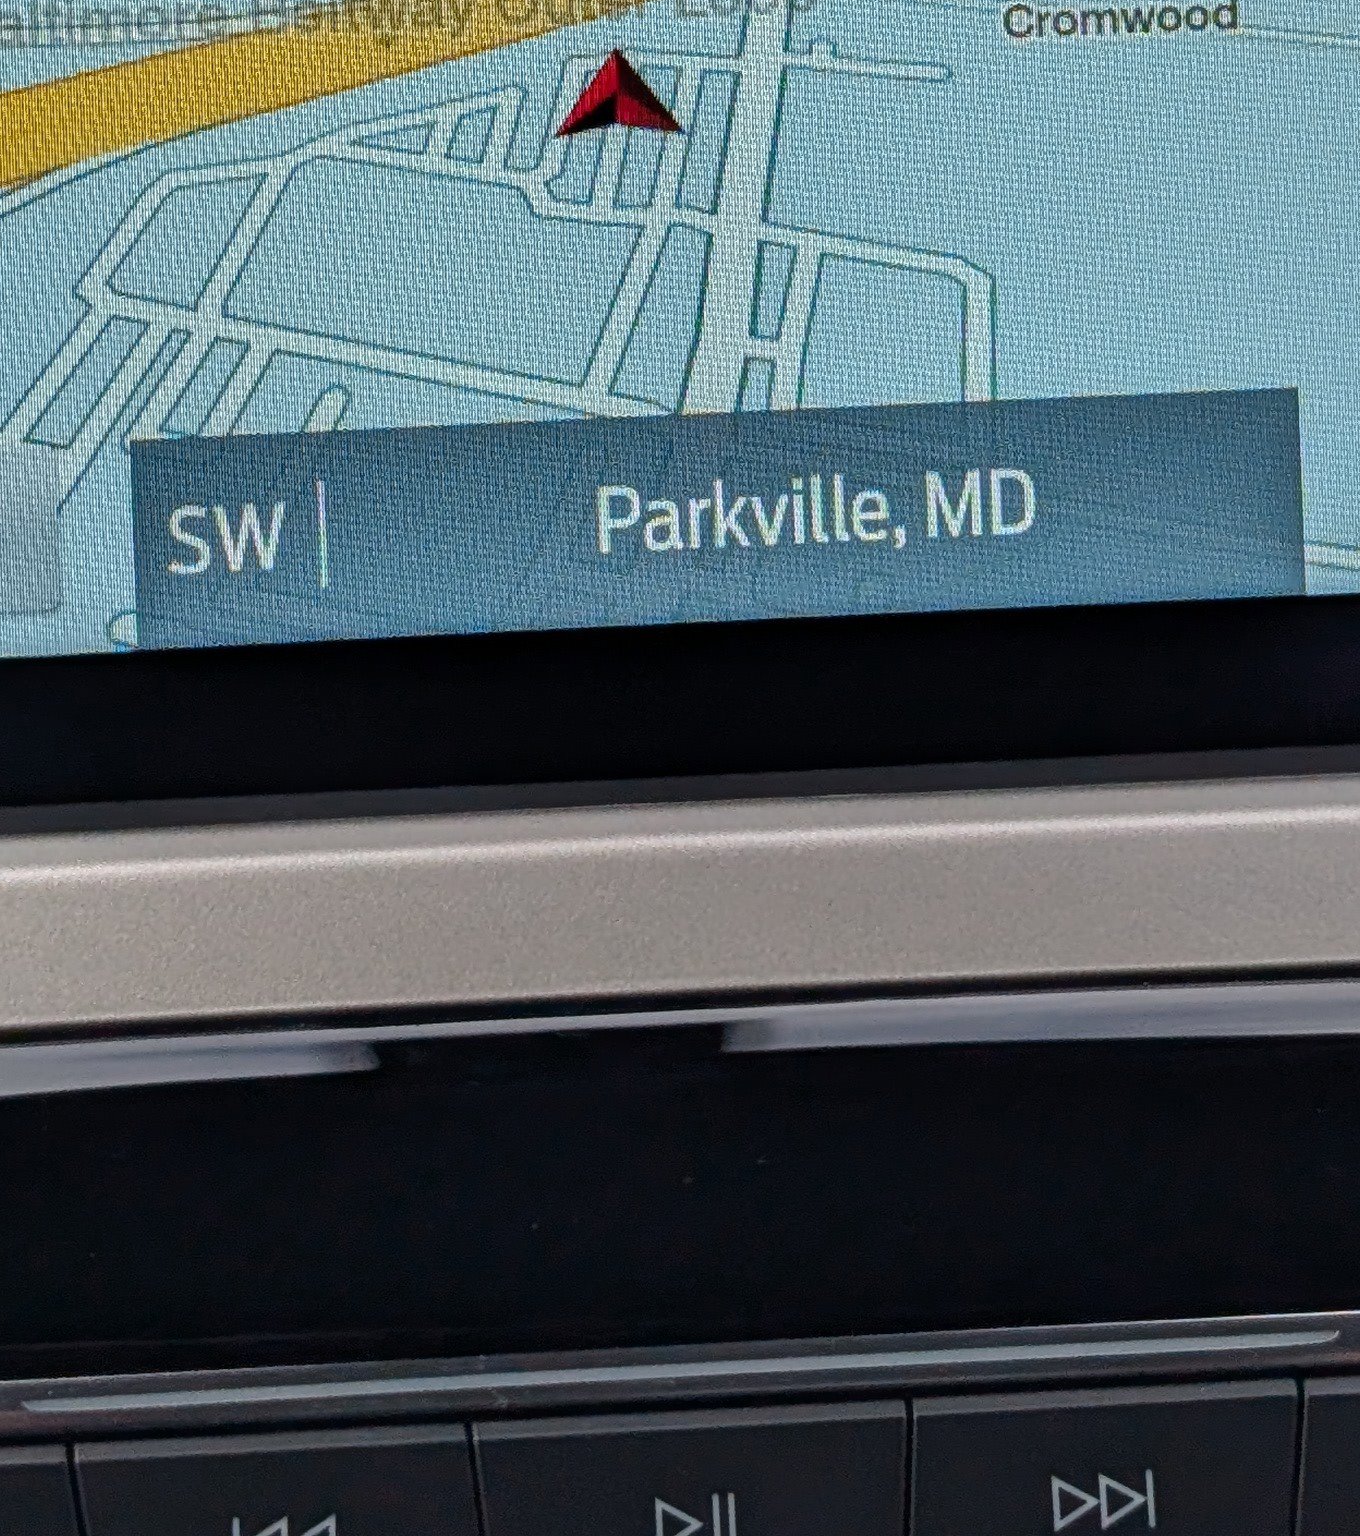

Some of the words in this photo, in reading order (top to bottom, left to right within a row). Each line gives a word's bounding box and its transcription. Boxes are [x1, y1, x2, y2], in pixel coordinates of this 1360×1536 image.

[167, 501, 285, 576] SW
[595, 471, 907, 554] Parkville,
[924, 467, 1037, 541] MD
